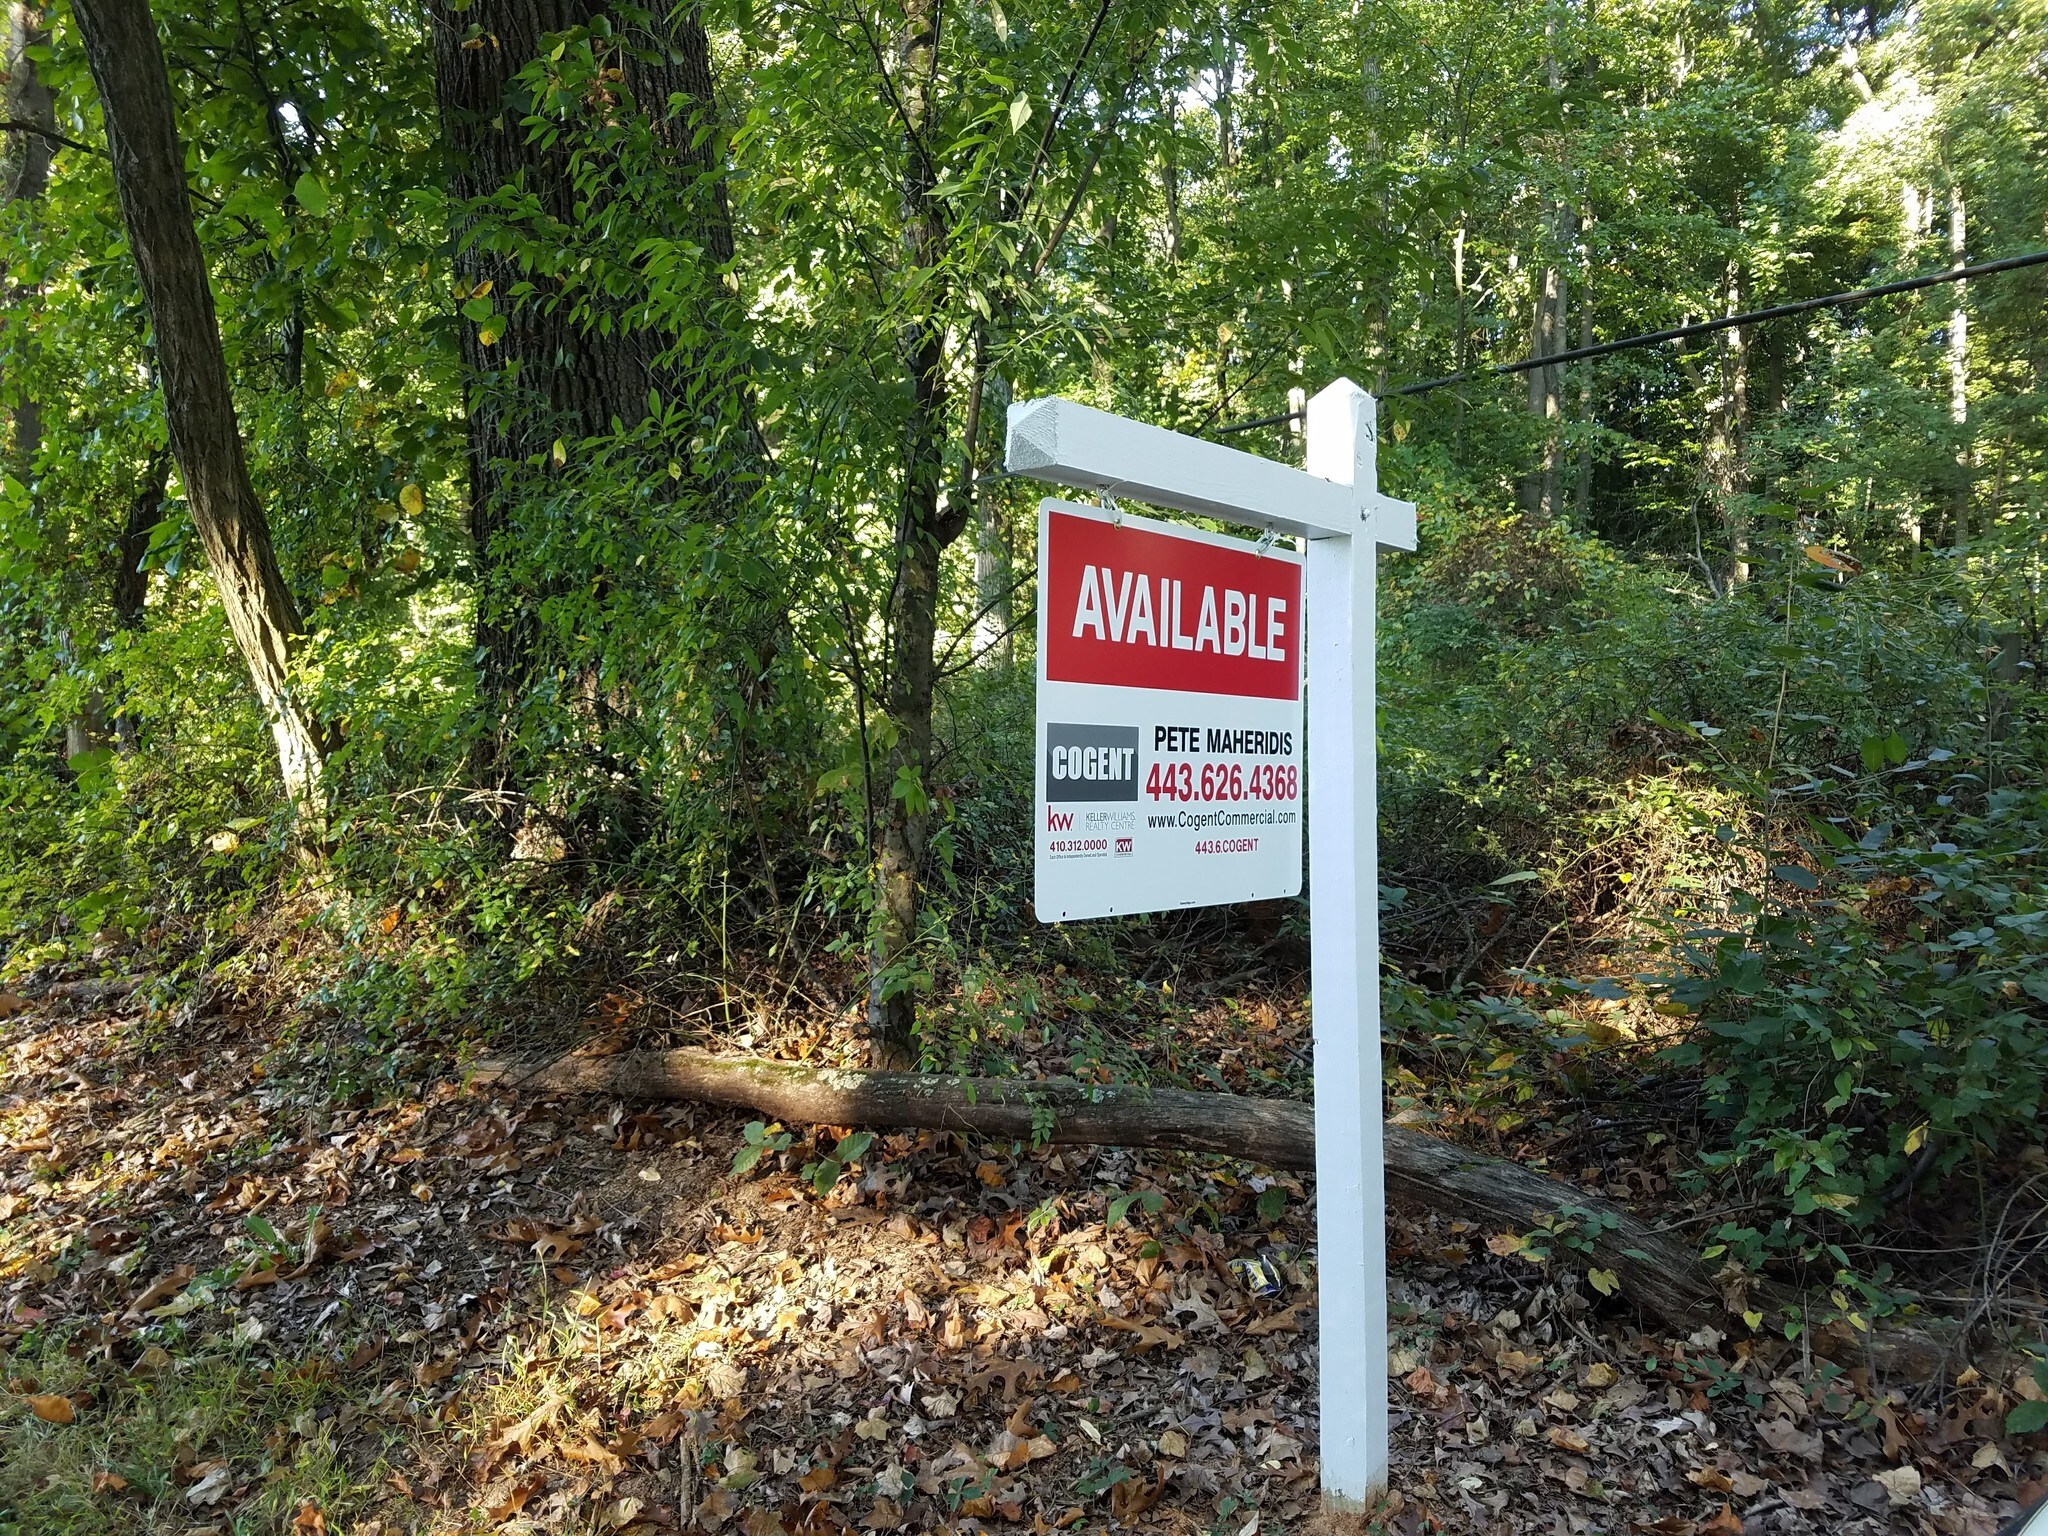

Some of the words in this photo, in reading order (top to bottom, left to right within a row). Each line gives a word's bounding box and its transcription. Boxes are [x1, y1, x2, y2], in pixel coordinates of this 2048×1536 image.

[1072, 564, 1287, 662] AVAILABLE
[1155, 725, 1200, 752] PETE
[1207, 728, 1292, 755] MAHERIDIS
[1052, 745, 1134, 781] COGENT
[1146, 762, 1298, 802] 443.626.4368
[1086, 822, 1109, 831] REALTY
[1111, 821, 1134, 830] CENTRE
[1148, 809, 1296, 831] www.CogentCommercial.com
[1050, 839, 1107, 852] 410.312.0000
[1116, 841, 1132, 852] KW
[1195, 838, 1259, 854] 443.6.COGENT
